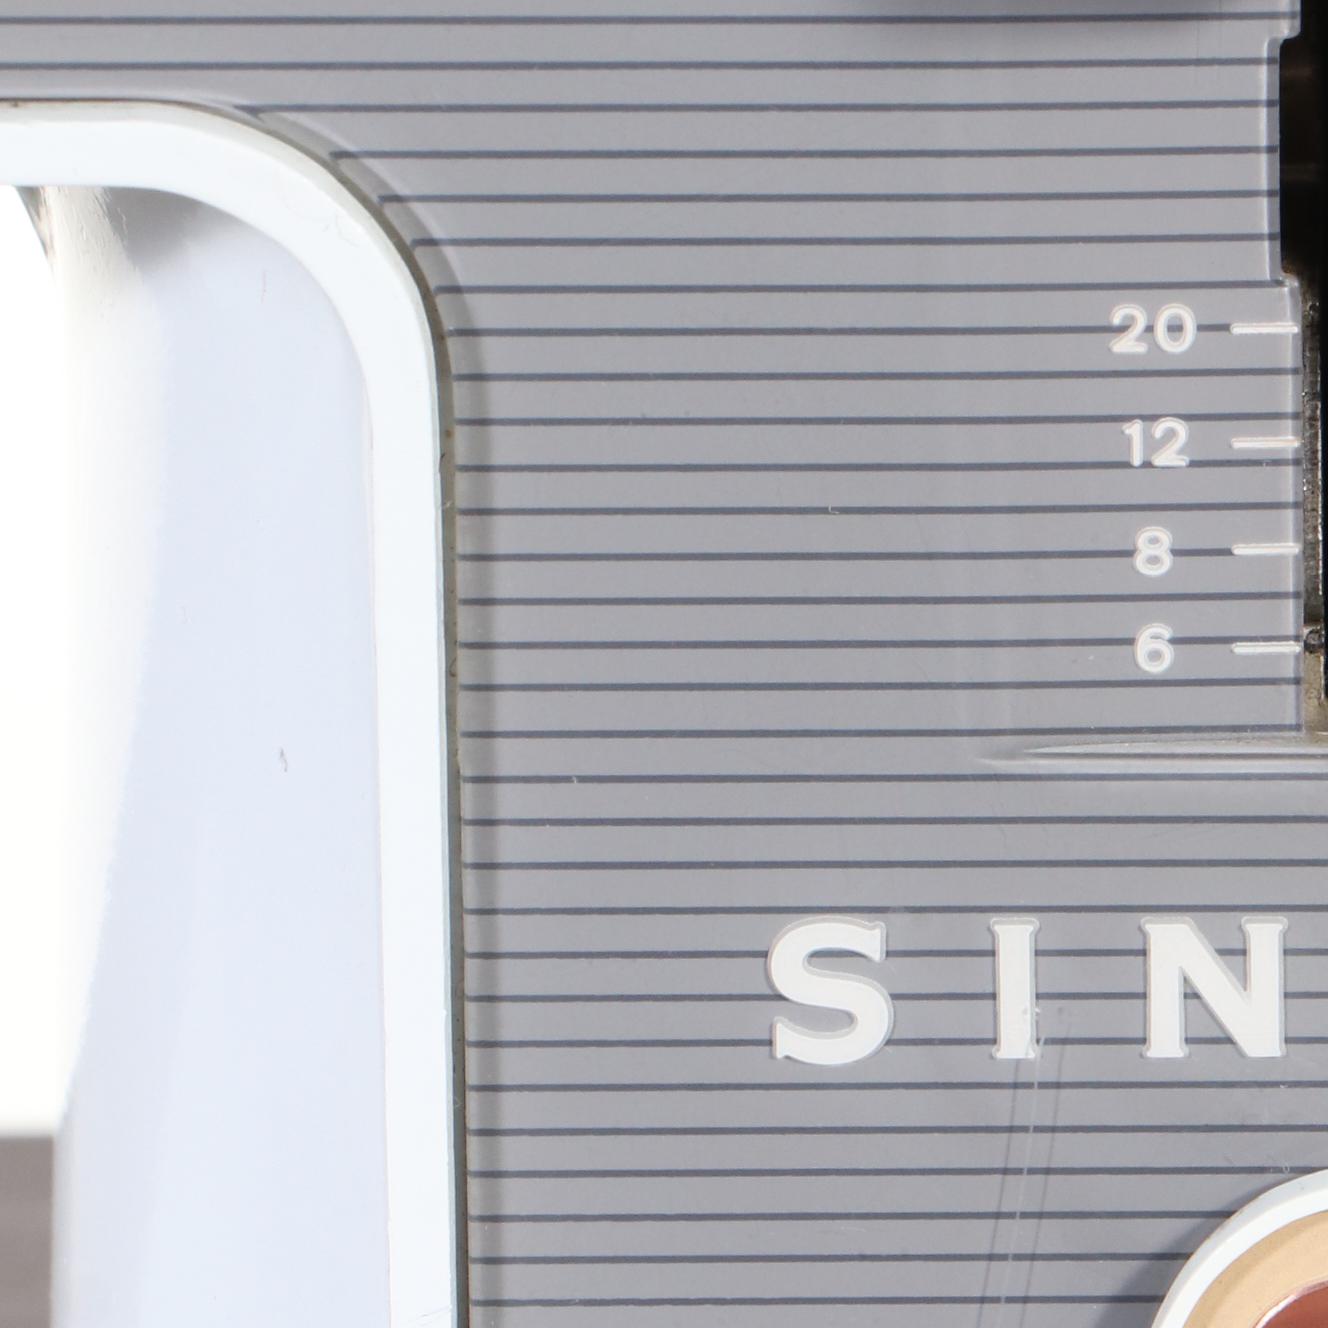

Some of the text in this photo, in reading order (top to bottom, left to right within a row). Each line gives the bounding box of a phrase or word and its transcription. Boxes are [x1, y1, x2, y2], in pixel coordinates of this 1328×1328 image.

[1109, 303, 1197, 354] 20
[1122, 417, 1189, 467] 12
[1135, 526, 1173, 577] 8
[1136, 622, 1175, 674] 6
